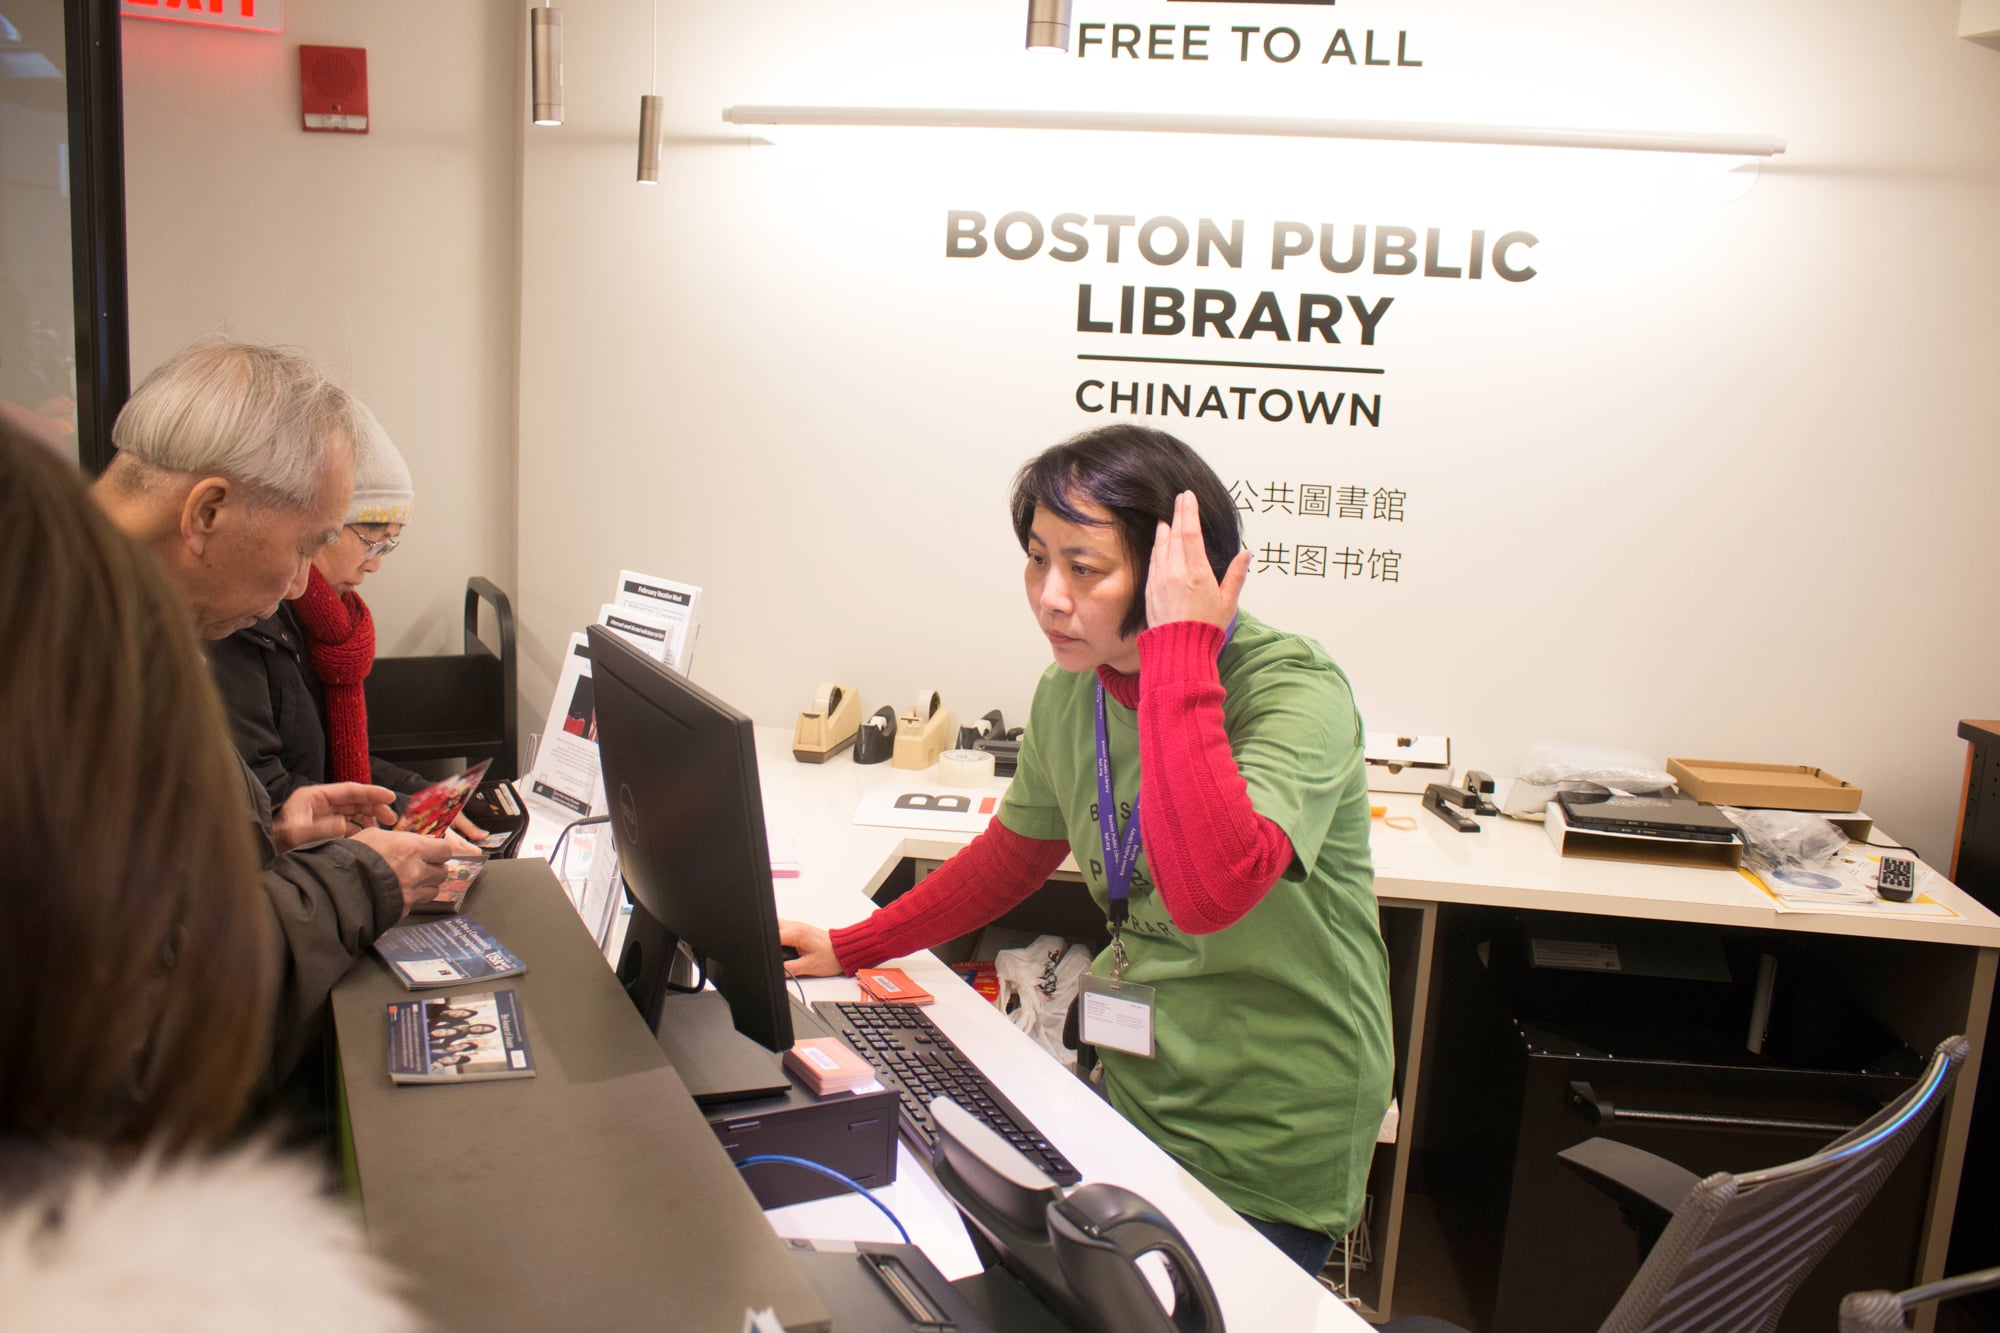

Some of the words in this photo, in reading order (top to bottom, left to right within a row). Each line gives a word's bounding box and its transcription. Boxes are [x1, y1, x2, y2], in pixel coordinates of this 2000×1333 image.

[1078, 22, 1211, 60] FREE
[1231, 26, 1302, 63] TO
[1321, 29, 1424, 68] ALL
[945, 209, 1245, 269] BOSTON
[1271, 220, 1541, 283] PUBLIC
[1076, 283, 1395, 347] LIBRARY
[1075, 379, 1382, 428] CHINATOWN
[1228, 480, 1407, 523] 公共圖書館
[1242, 541, 1402, 583] 共图书馆
